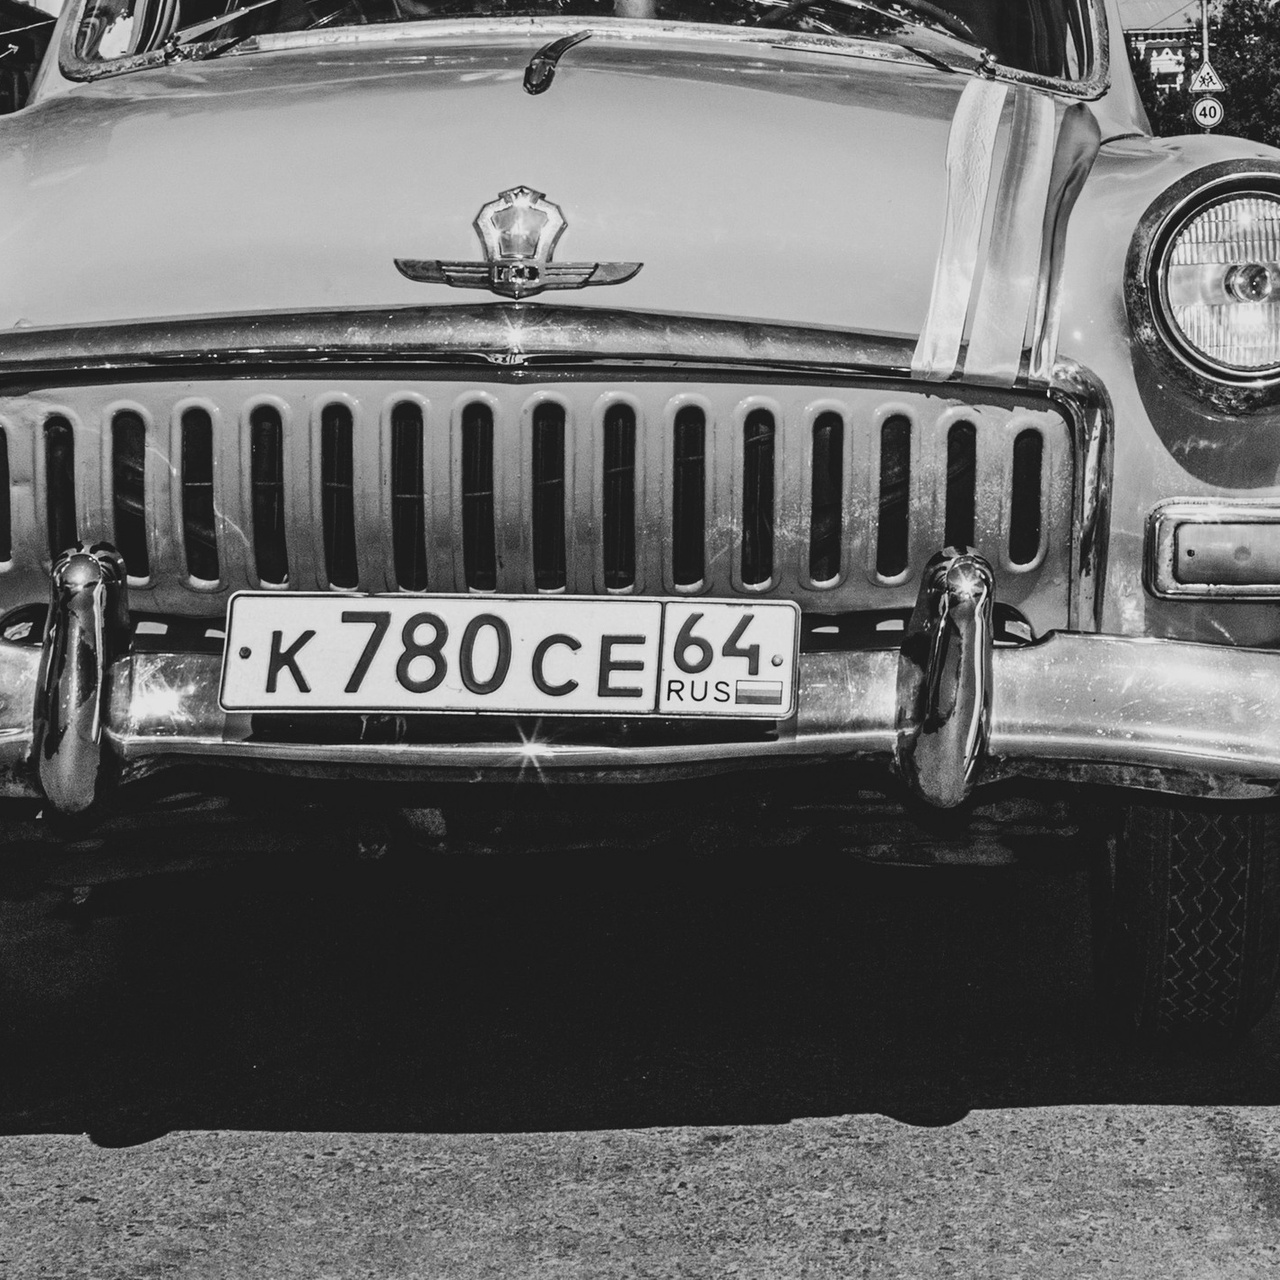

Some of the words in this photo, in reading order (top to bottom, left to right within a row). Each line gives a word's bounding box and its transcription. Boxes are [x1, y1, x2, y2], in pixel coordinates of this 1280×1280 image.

[1199, 106, 1217, 118] 40
[673, 612, 761, 676] 64
[667, 679, 731, 703] RUS
